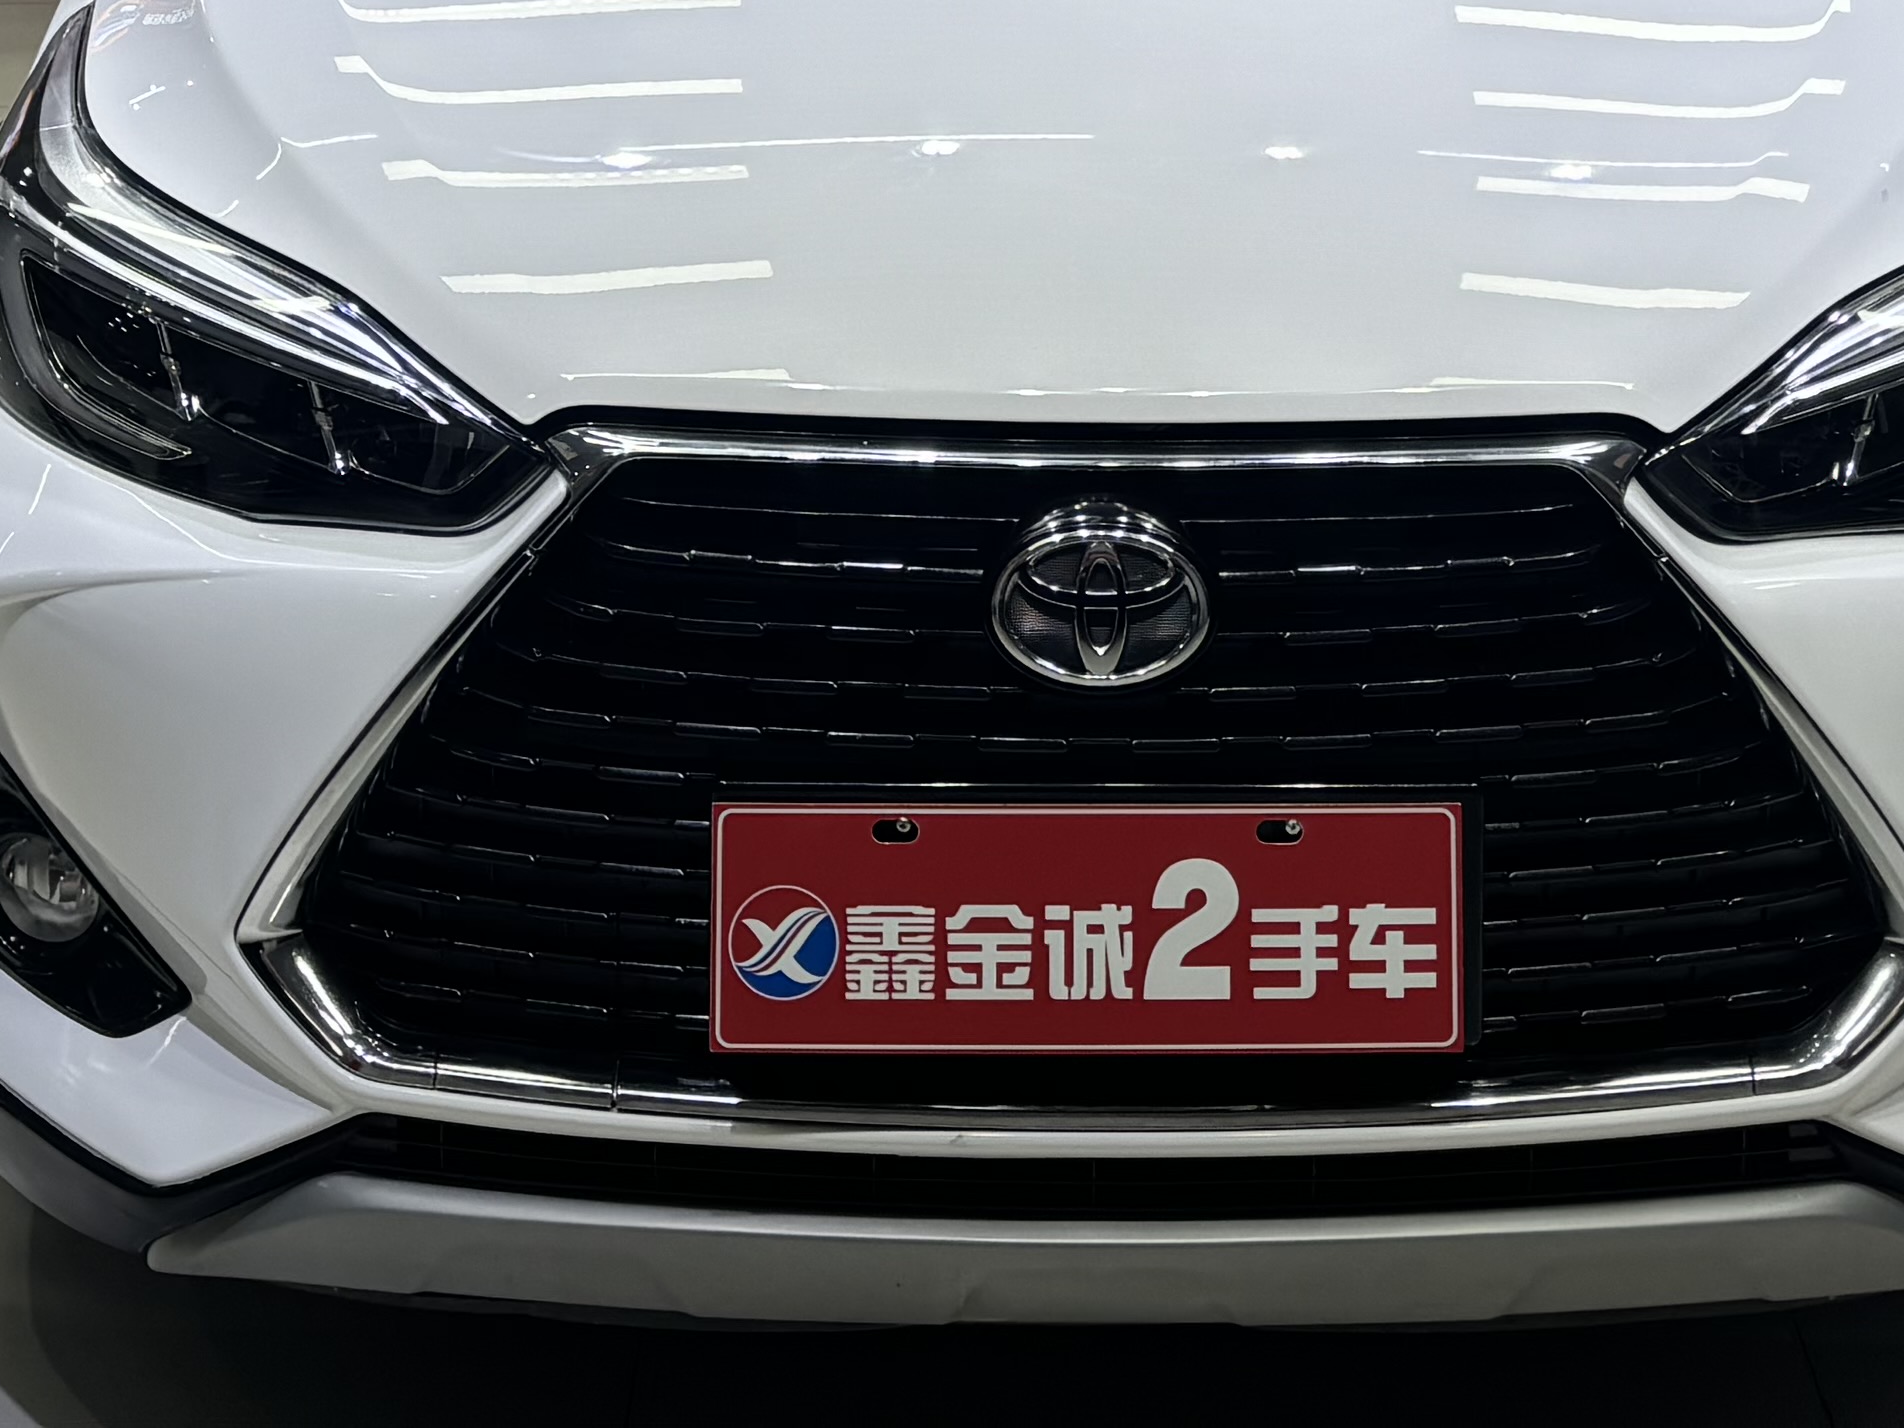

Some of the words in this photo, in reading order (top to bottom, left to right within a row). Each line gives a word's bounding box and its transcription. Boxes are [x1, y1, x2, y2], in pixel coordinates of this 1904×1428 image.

[844, 857, 1437, 1001] 鑫金诚2手车
